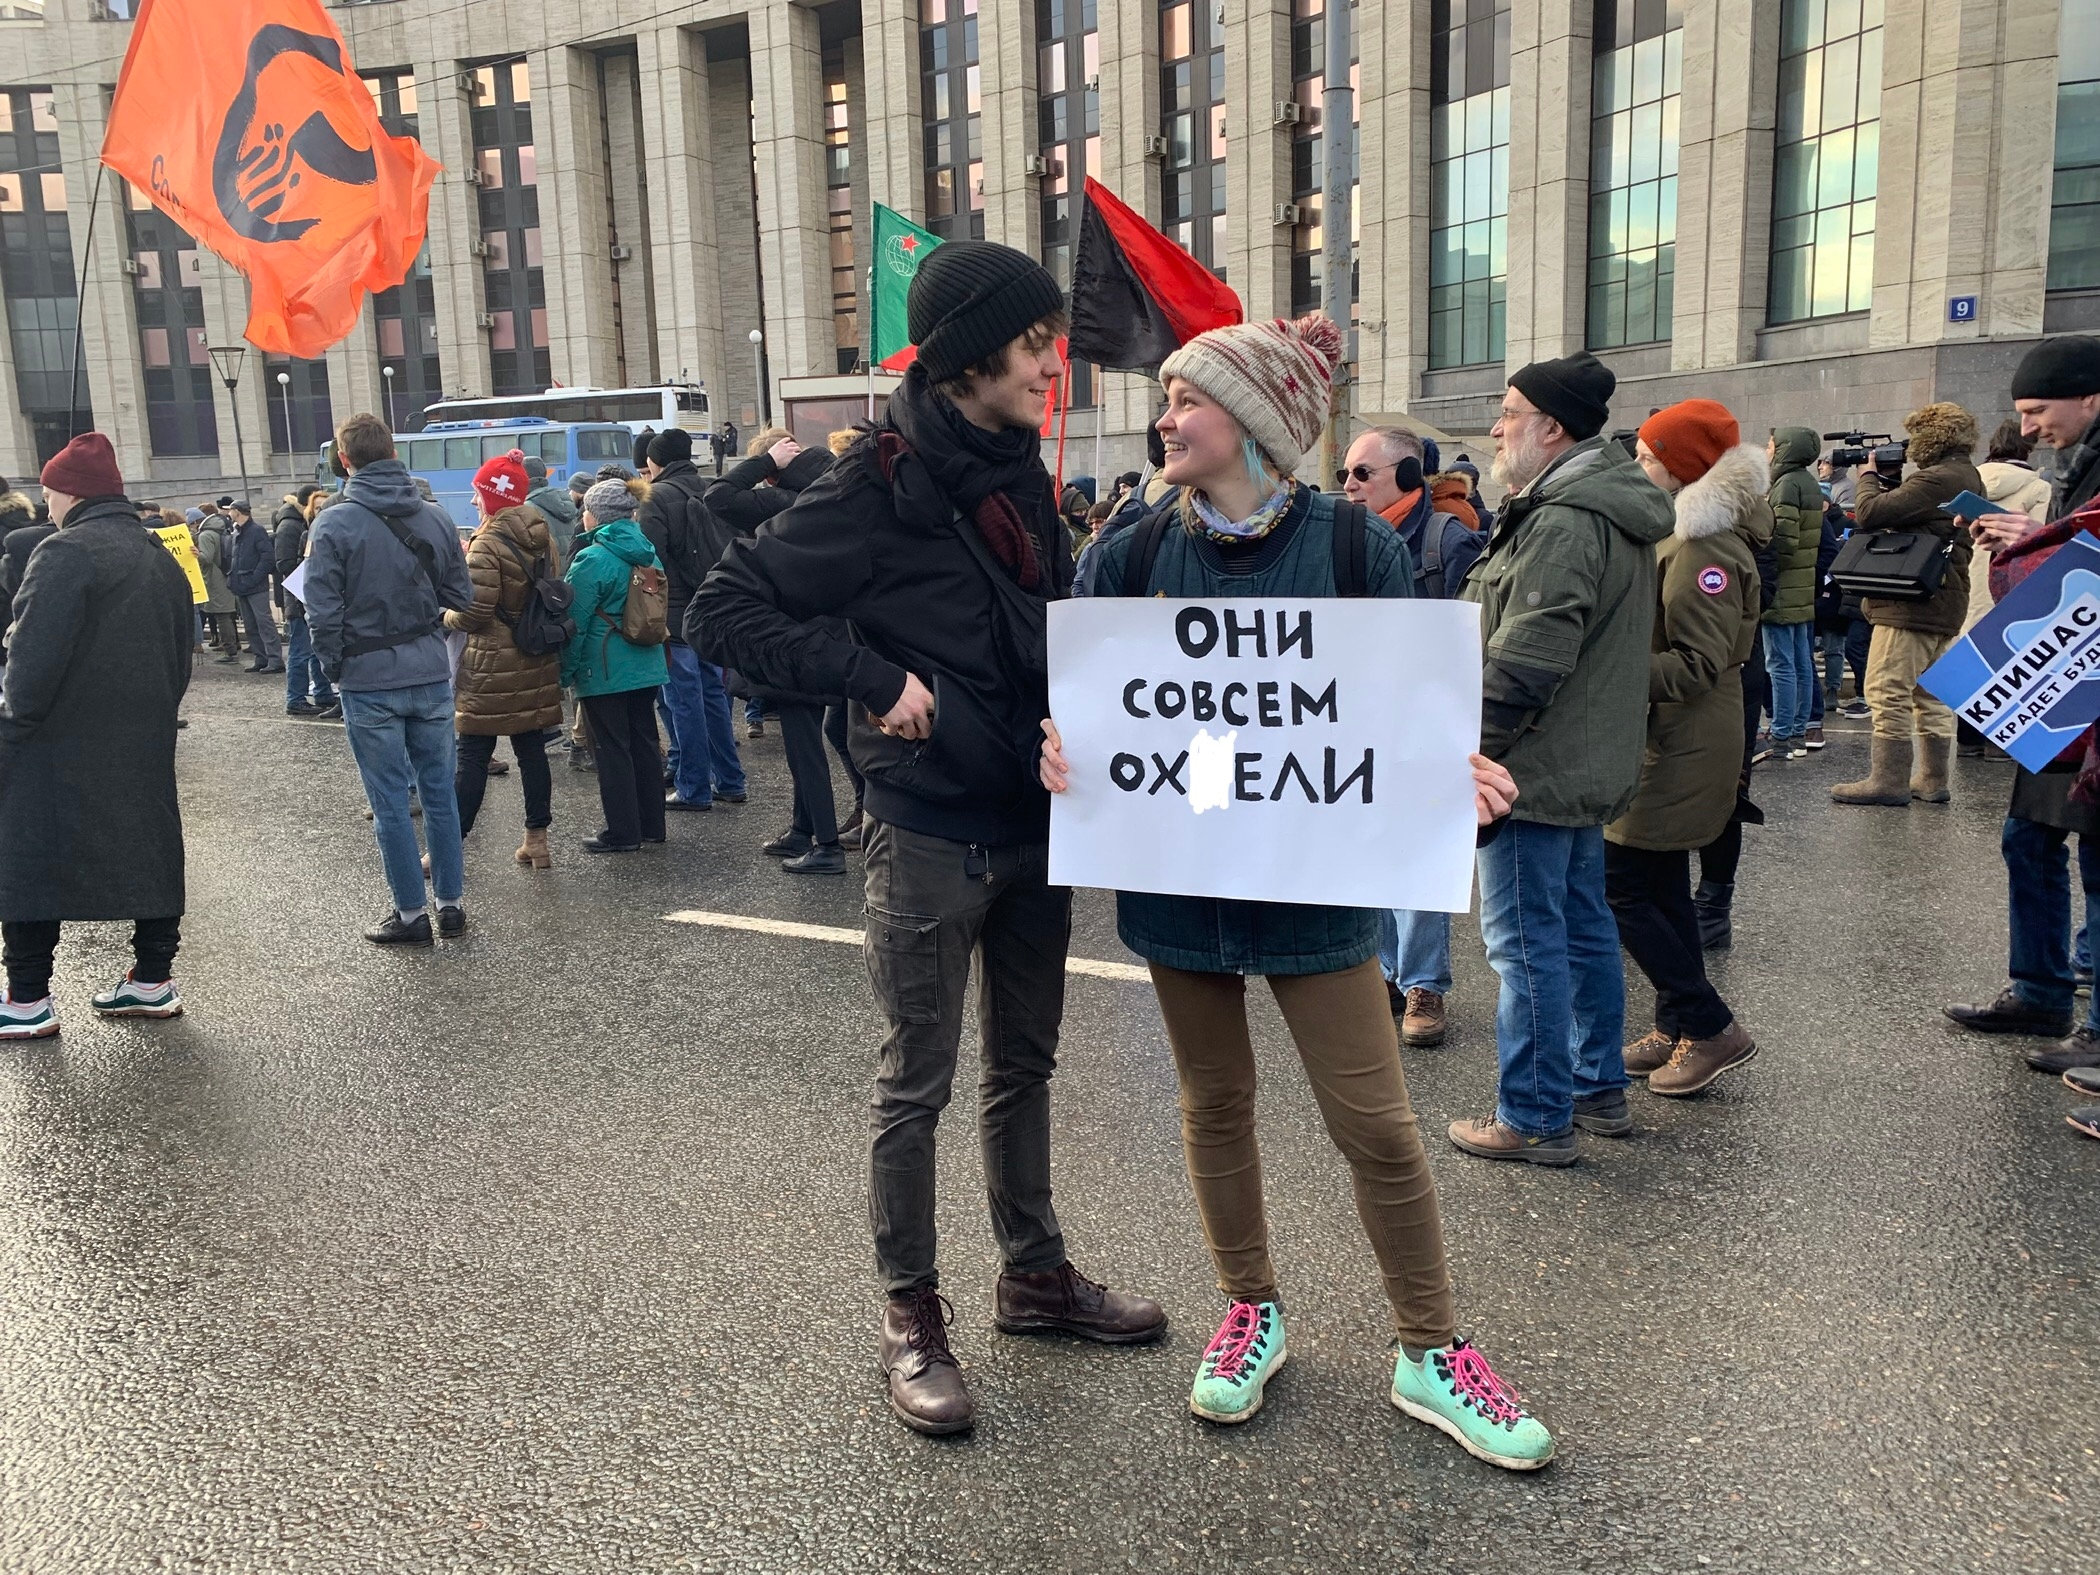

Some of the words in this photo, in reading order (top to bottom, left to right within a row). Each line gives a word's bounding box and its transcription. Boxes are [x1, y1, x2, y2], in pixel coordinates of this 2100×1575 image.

[1957, 301, 1969, 317] 9
[476, 482, 521, 503] SWITZERLAND
[1175, 606, 1314, 659] ОНИ
[1964, 606, 2097, 724] КЛИШАС
[1123, 678, 1339, 728] СОВСЕМ
[1994, 682, 2062, 744] КРАДЕТ
[2062, 641, 2100, 681] БУД
[1109, 745, 1374, 804] ОХЕЛИ
